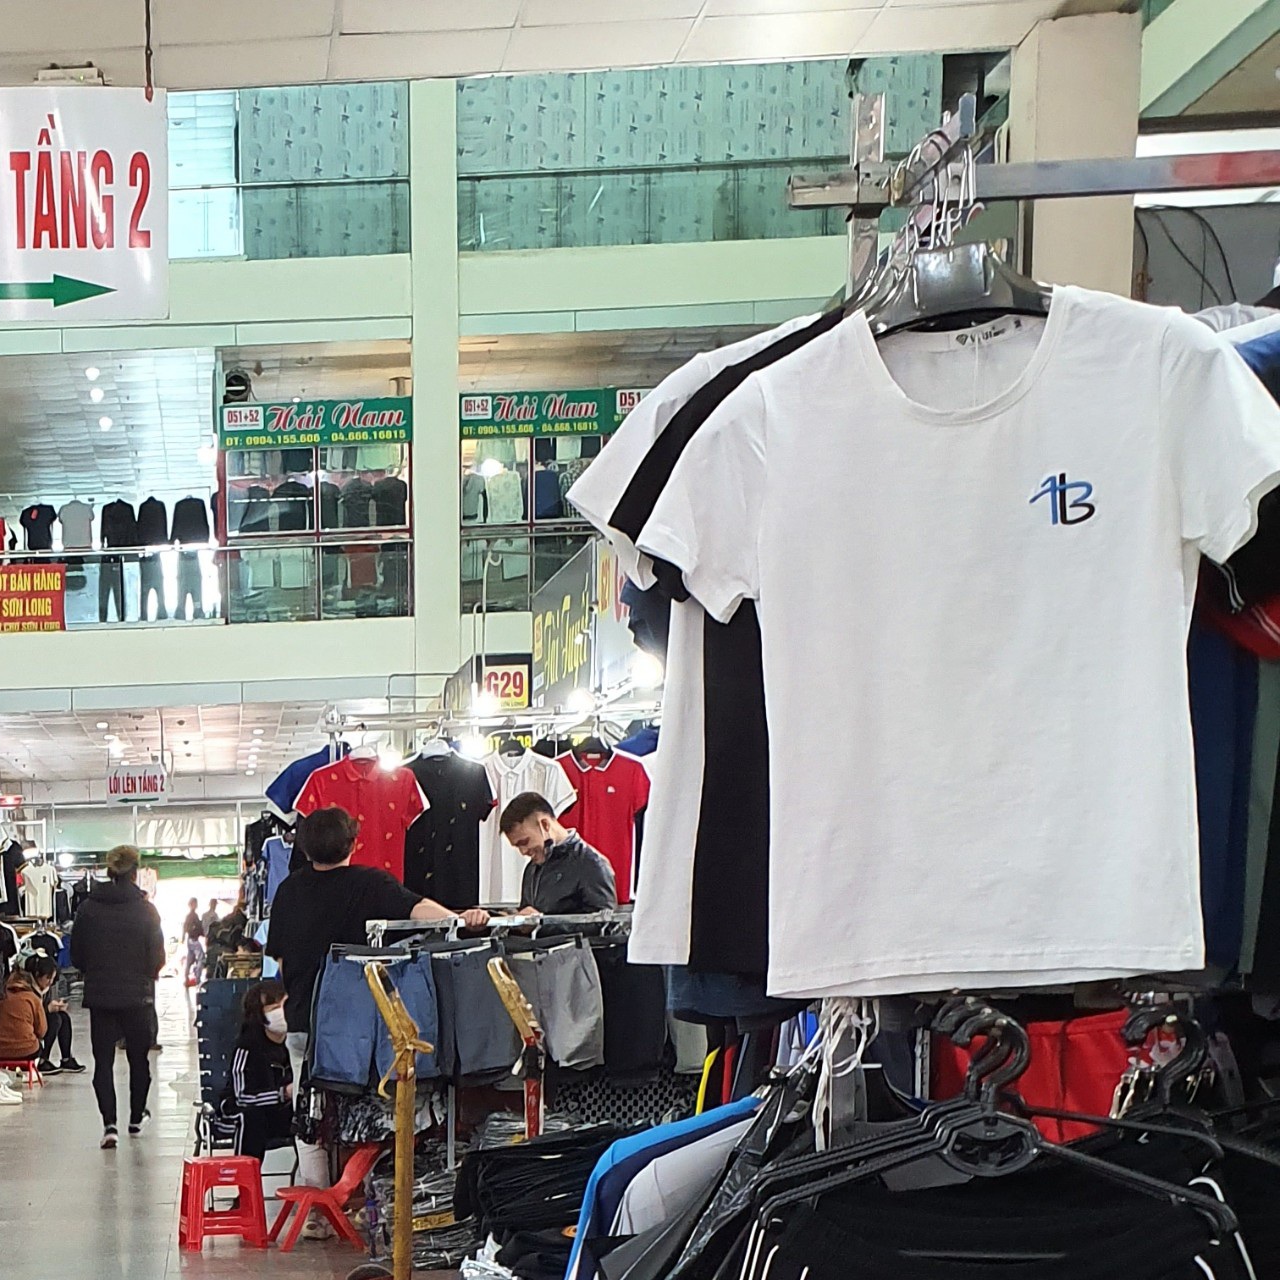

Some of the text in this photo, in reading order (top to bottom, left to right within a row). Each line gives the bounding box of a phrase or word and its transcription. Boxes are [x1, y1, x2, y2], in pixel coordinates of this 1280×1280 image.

[9, 113, 114, 250] TẦNG
[128, 151, 152, 249] 2
[331, 402, 407, 429] Nam
[542, 393, 599, 420] Nam
[10, 569, 31, 591] BÁN
[33, 568, 61, 591] HÀNG
[25, 597, 52, 616] LONG
[487, 671, 524, 698] G29
[160, 774, 165, 792] 2
